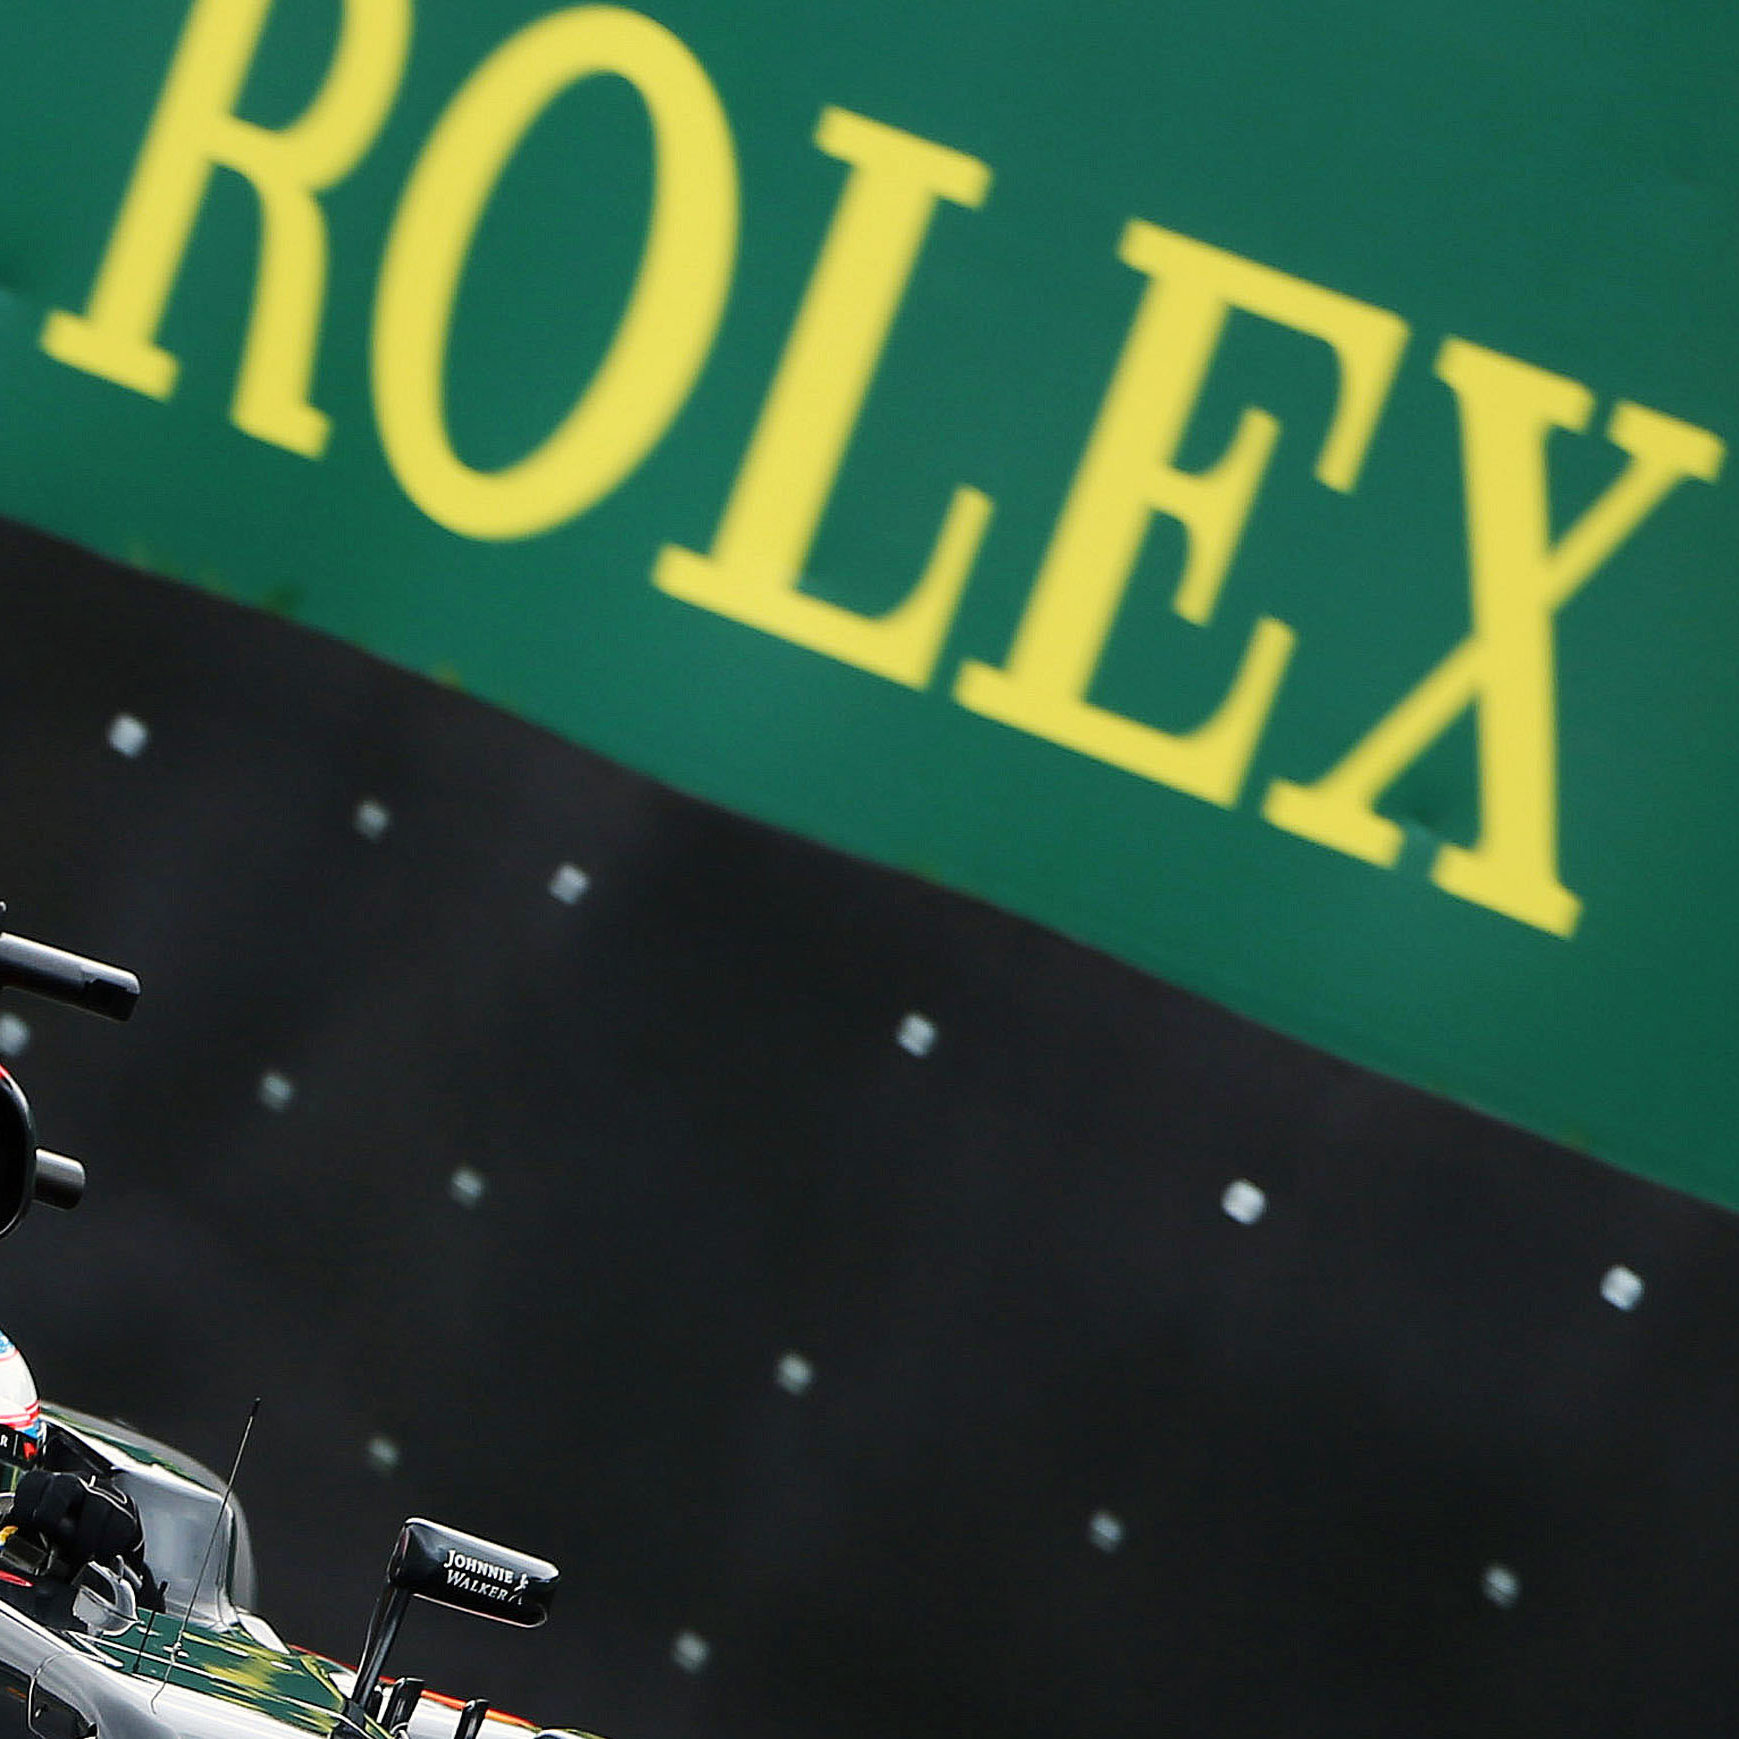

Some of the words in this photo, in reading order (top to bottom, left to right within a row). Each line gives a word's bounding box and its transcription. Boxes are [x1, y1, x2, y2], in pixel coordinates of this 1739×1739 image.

[39, 0, 1727, 941] ROLEX
[443, 1549, 515, 1584] JOHNNIE
[446, 1568, 509, 1602] WALKER
